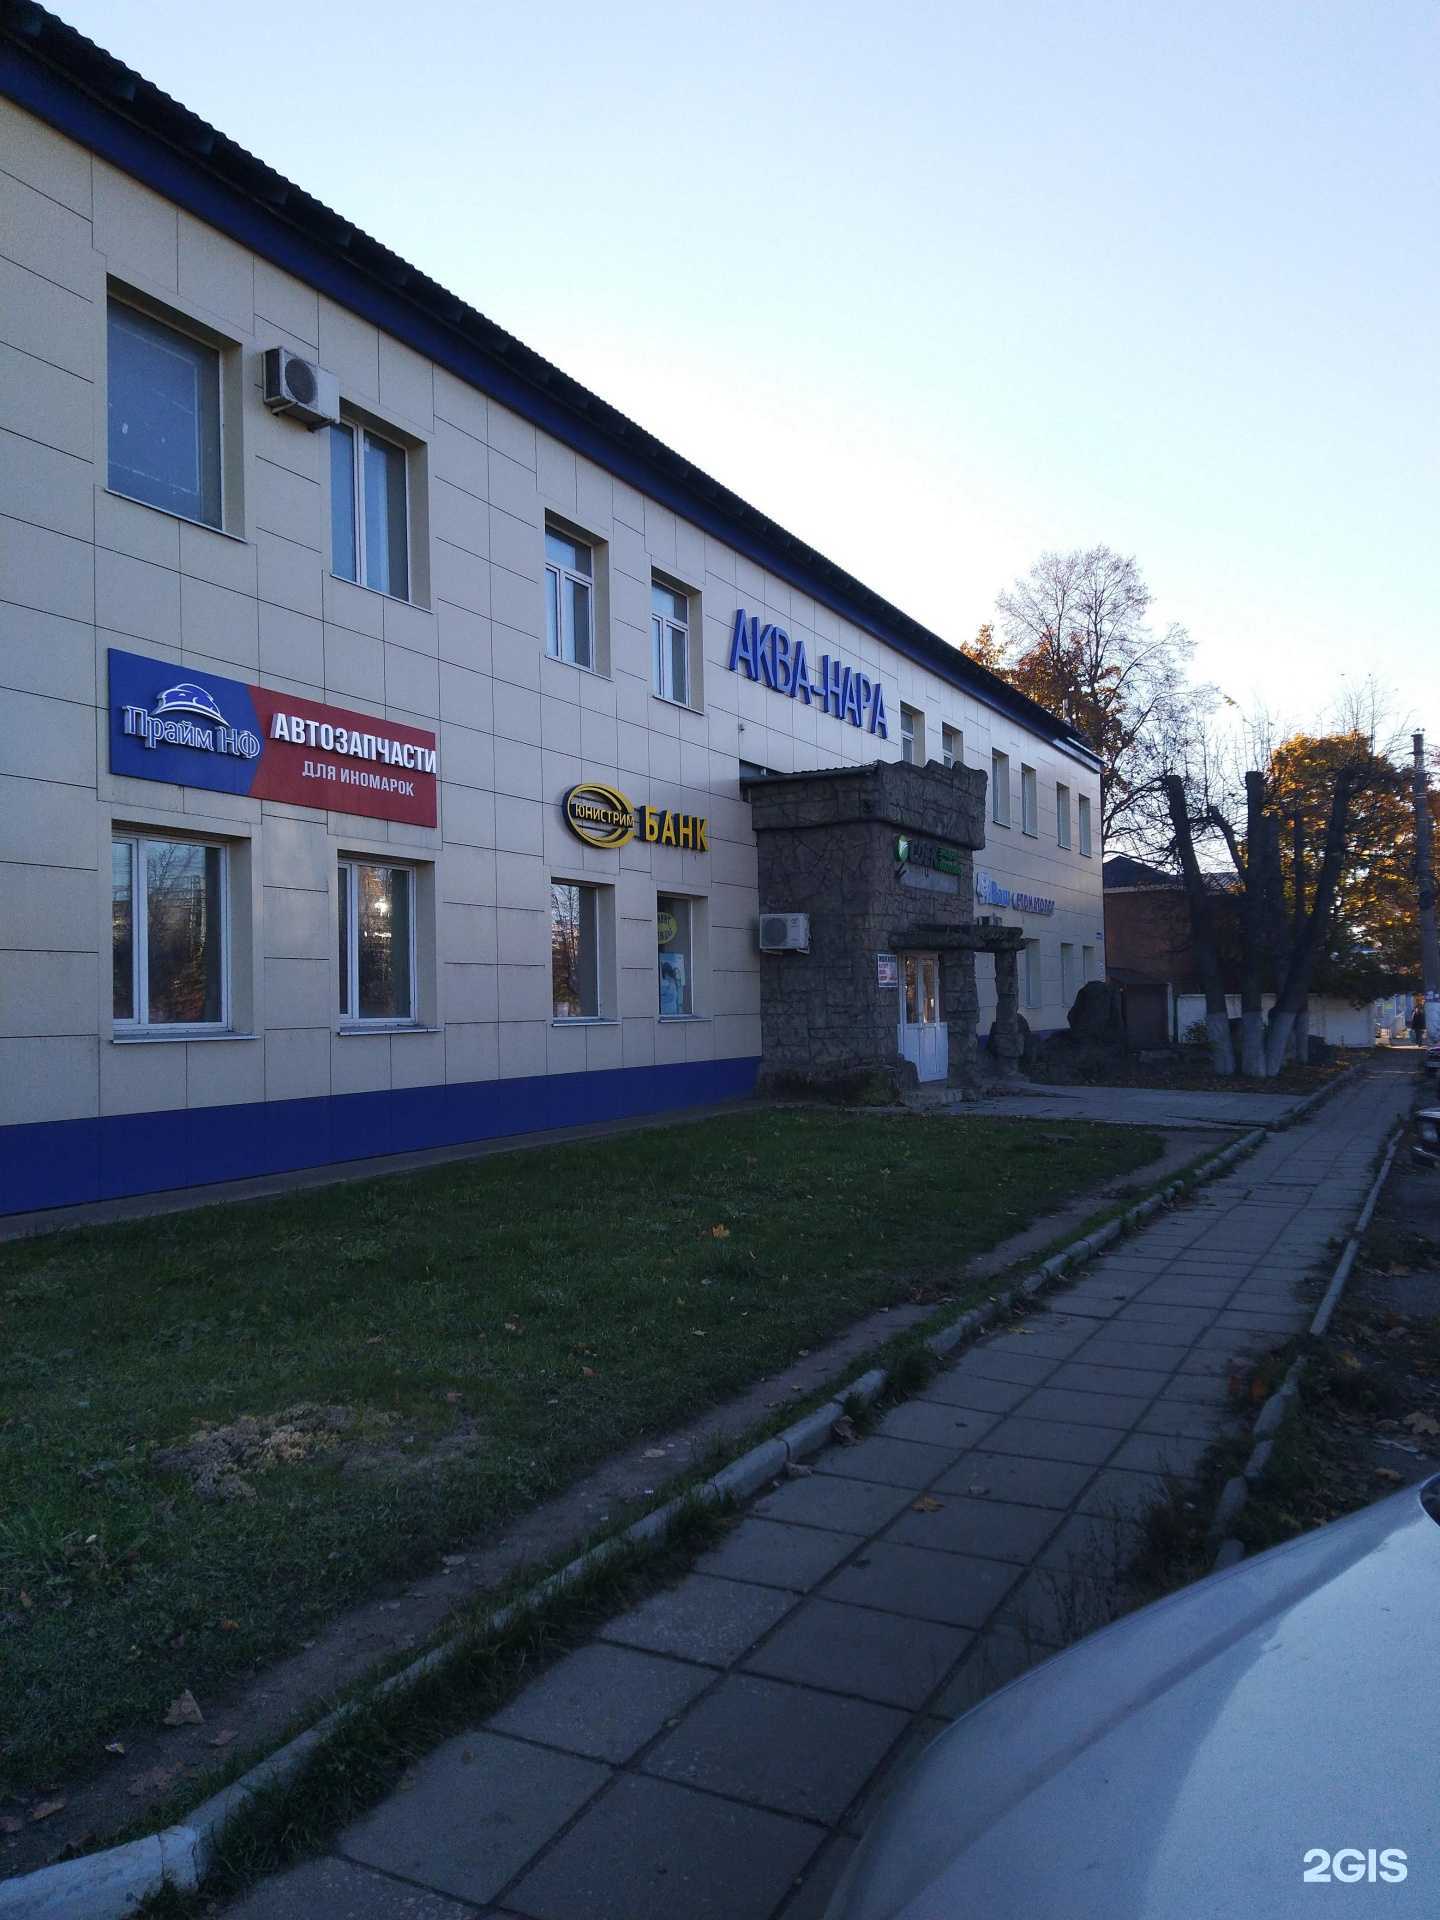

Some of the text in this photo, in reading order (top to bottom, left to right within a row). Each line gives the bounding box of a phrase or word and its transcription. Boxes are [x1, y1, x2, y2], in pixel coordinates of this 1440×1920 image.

[729, 608, 889, 739] АКВА-НАРА
[122, 705, 260, 759] Прайм НФ
[270, 713, 437, 774] АВТОЗАПЧАСТИ
[302, 761, 415, 797] ДЛЯ ИНОМАРОК
[574, 804, 634, 827] ЮНИСТРИМ
[643, 805, 709, 851] БАНК
